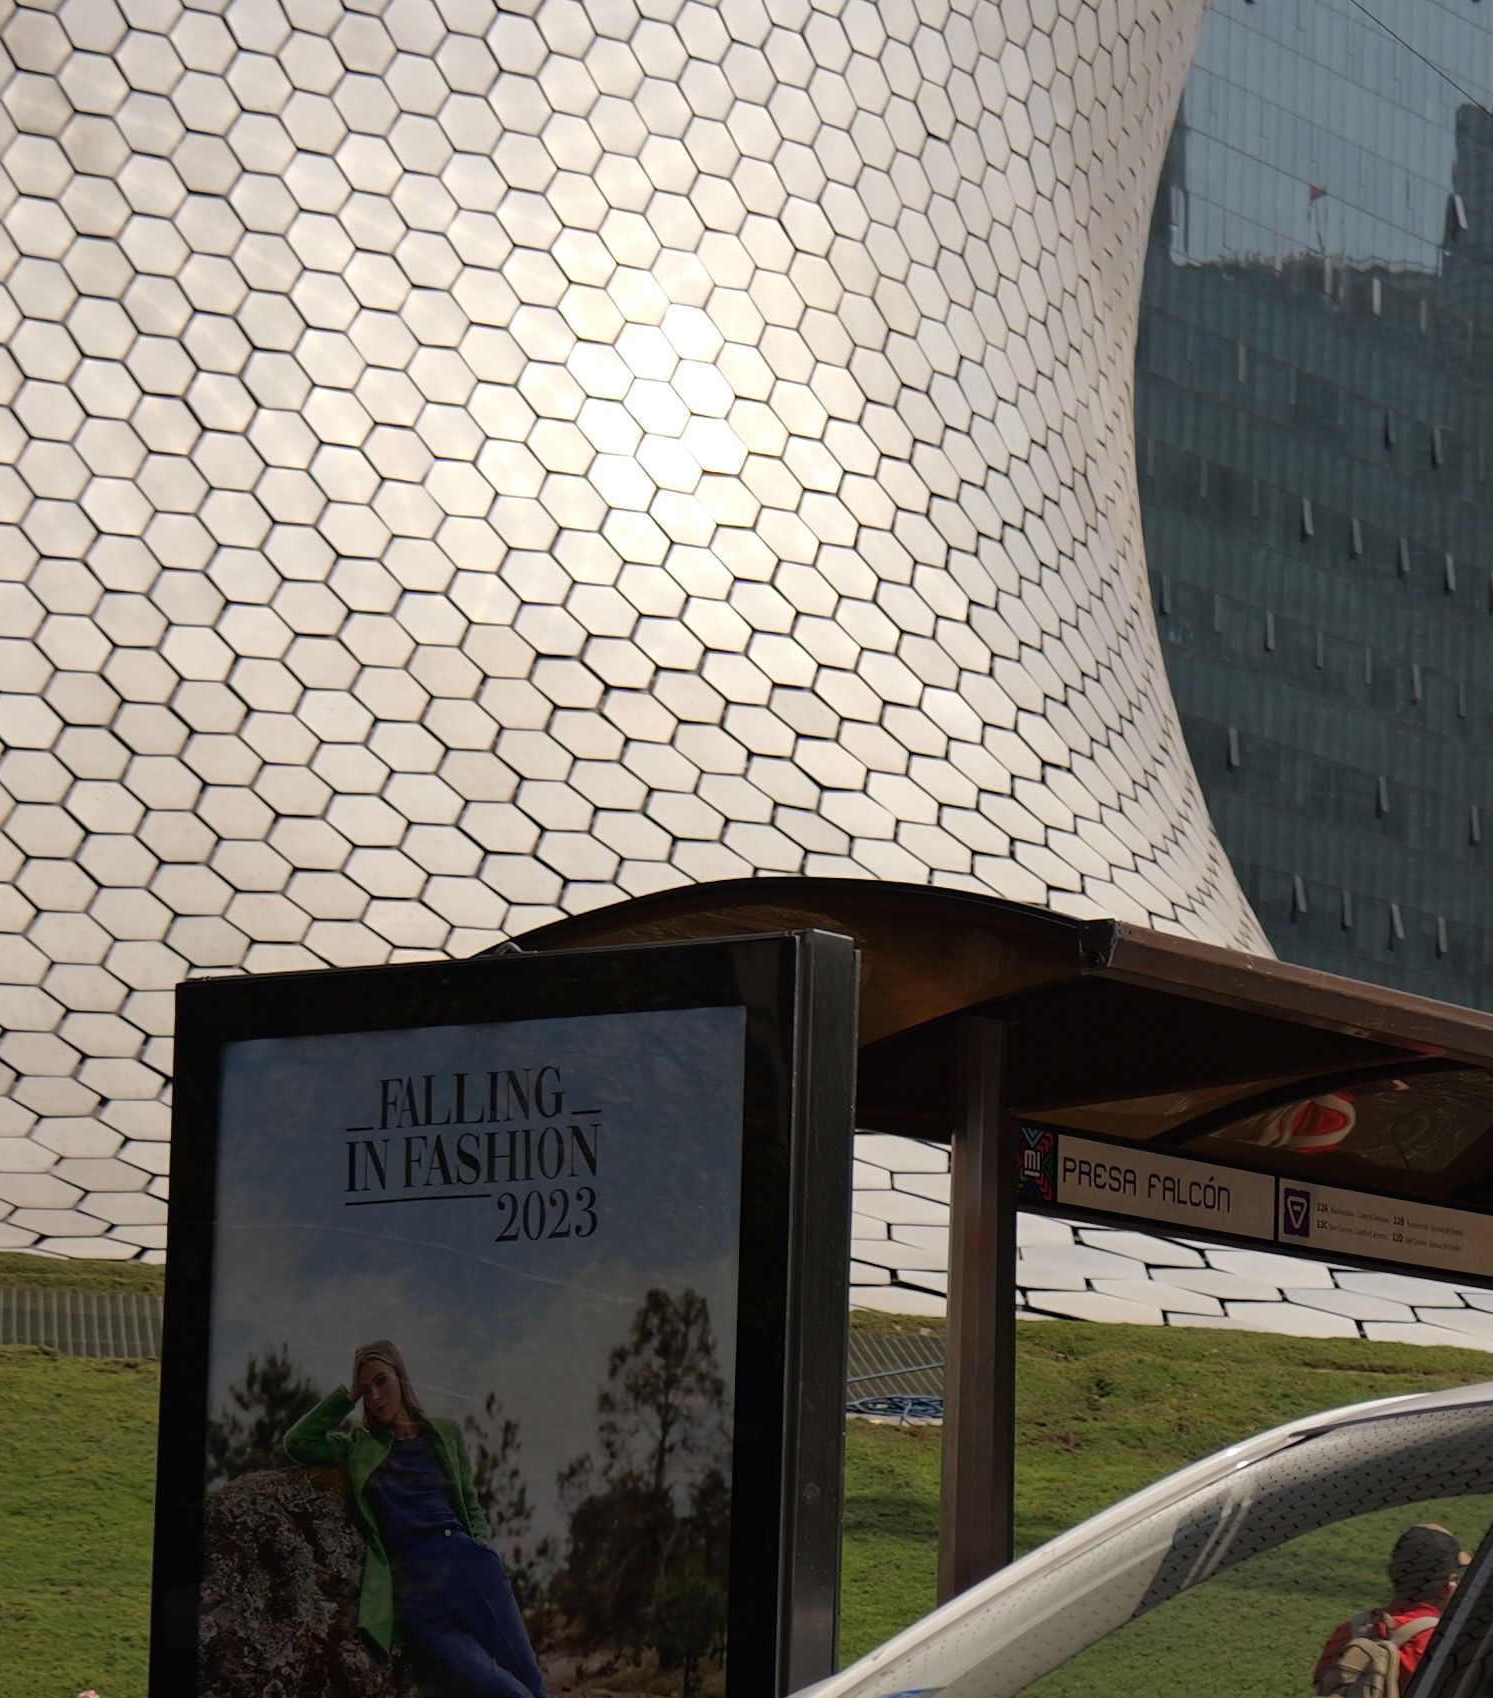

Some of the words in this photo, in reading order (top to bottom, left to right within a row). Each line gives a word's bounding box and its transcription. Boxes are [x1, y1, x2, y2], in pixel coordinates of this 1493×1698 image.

[378, 1065, 566, 1130] FALLING
[344, 1137, 389, 1193] IN
[403, 1123, 601, 1188] FASHION
[1062, 1156, 1137, 1196] PRESA
[1147, 1175, 1231, 1213] FALCÓN
[494, 1186, 598, 1243] 2023
